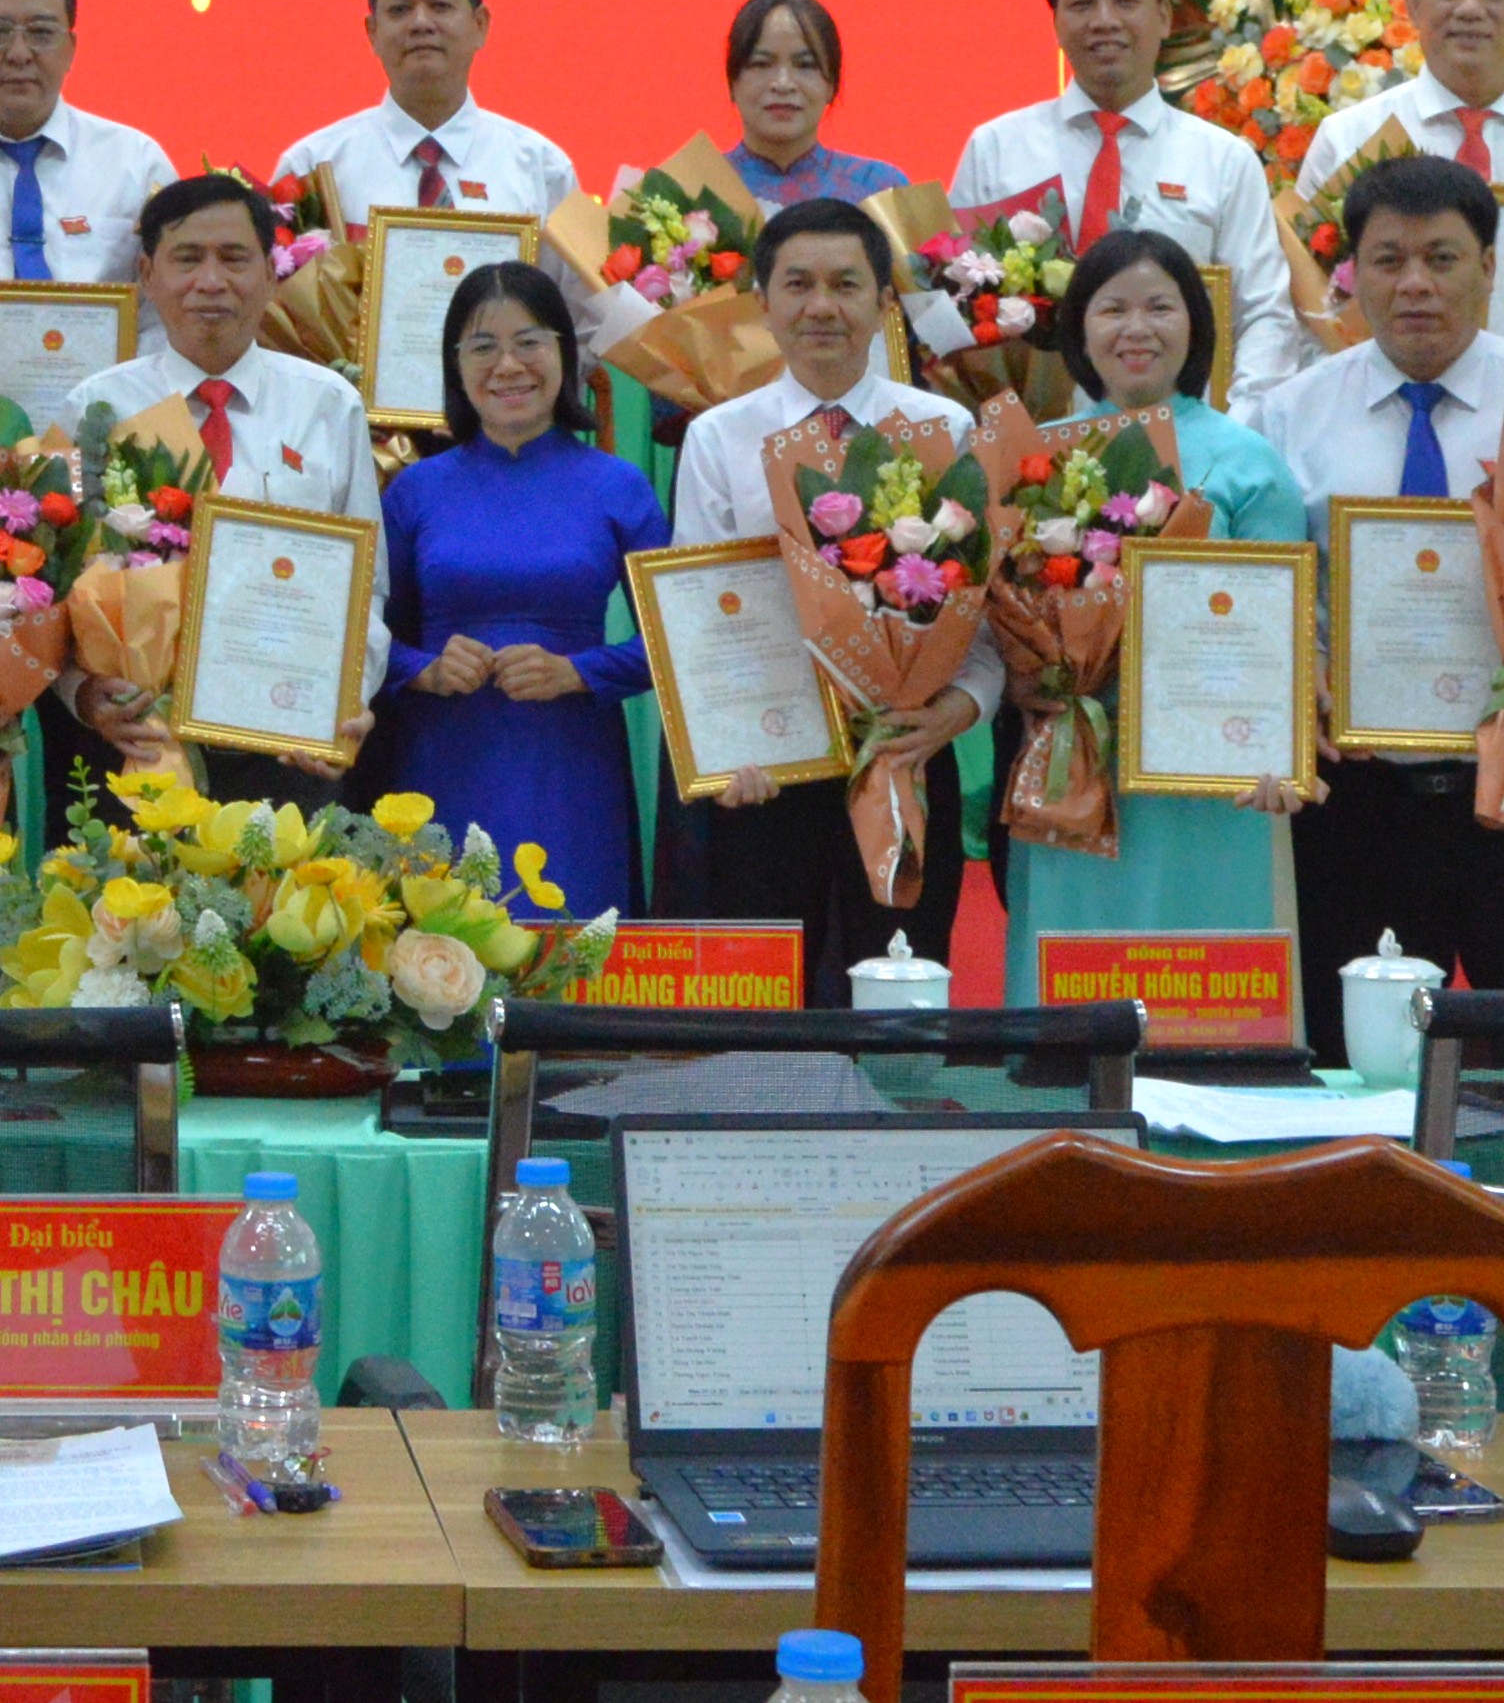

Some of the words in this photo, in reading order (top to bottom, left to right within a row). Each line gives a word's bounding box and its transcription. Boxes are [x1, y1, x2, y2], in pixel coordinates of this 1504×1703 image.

[622, 942, 652, 964] Đại
[657, 939, 694, 960] biểu
[586, 967, 676, 1006] HOÀNG
[683, 971, 790, 1007] KHƯƠNG
[1054, 963, 1138, 999] NGUYỄN
[1208, 967, 1279, 999] DUYÊN
[9, 1222, 53, 1254] Đại
[60, 1218, 113, 1249] biểu
[81, 1261, 204, 1317] CHÂU
[33, 1328, 69, 1347] nhân
[73, 1328, 101, 1347] dân
[105, 1328, 160, 1350] phường
